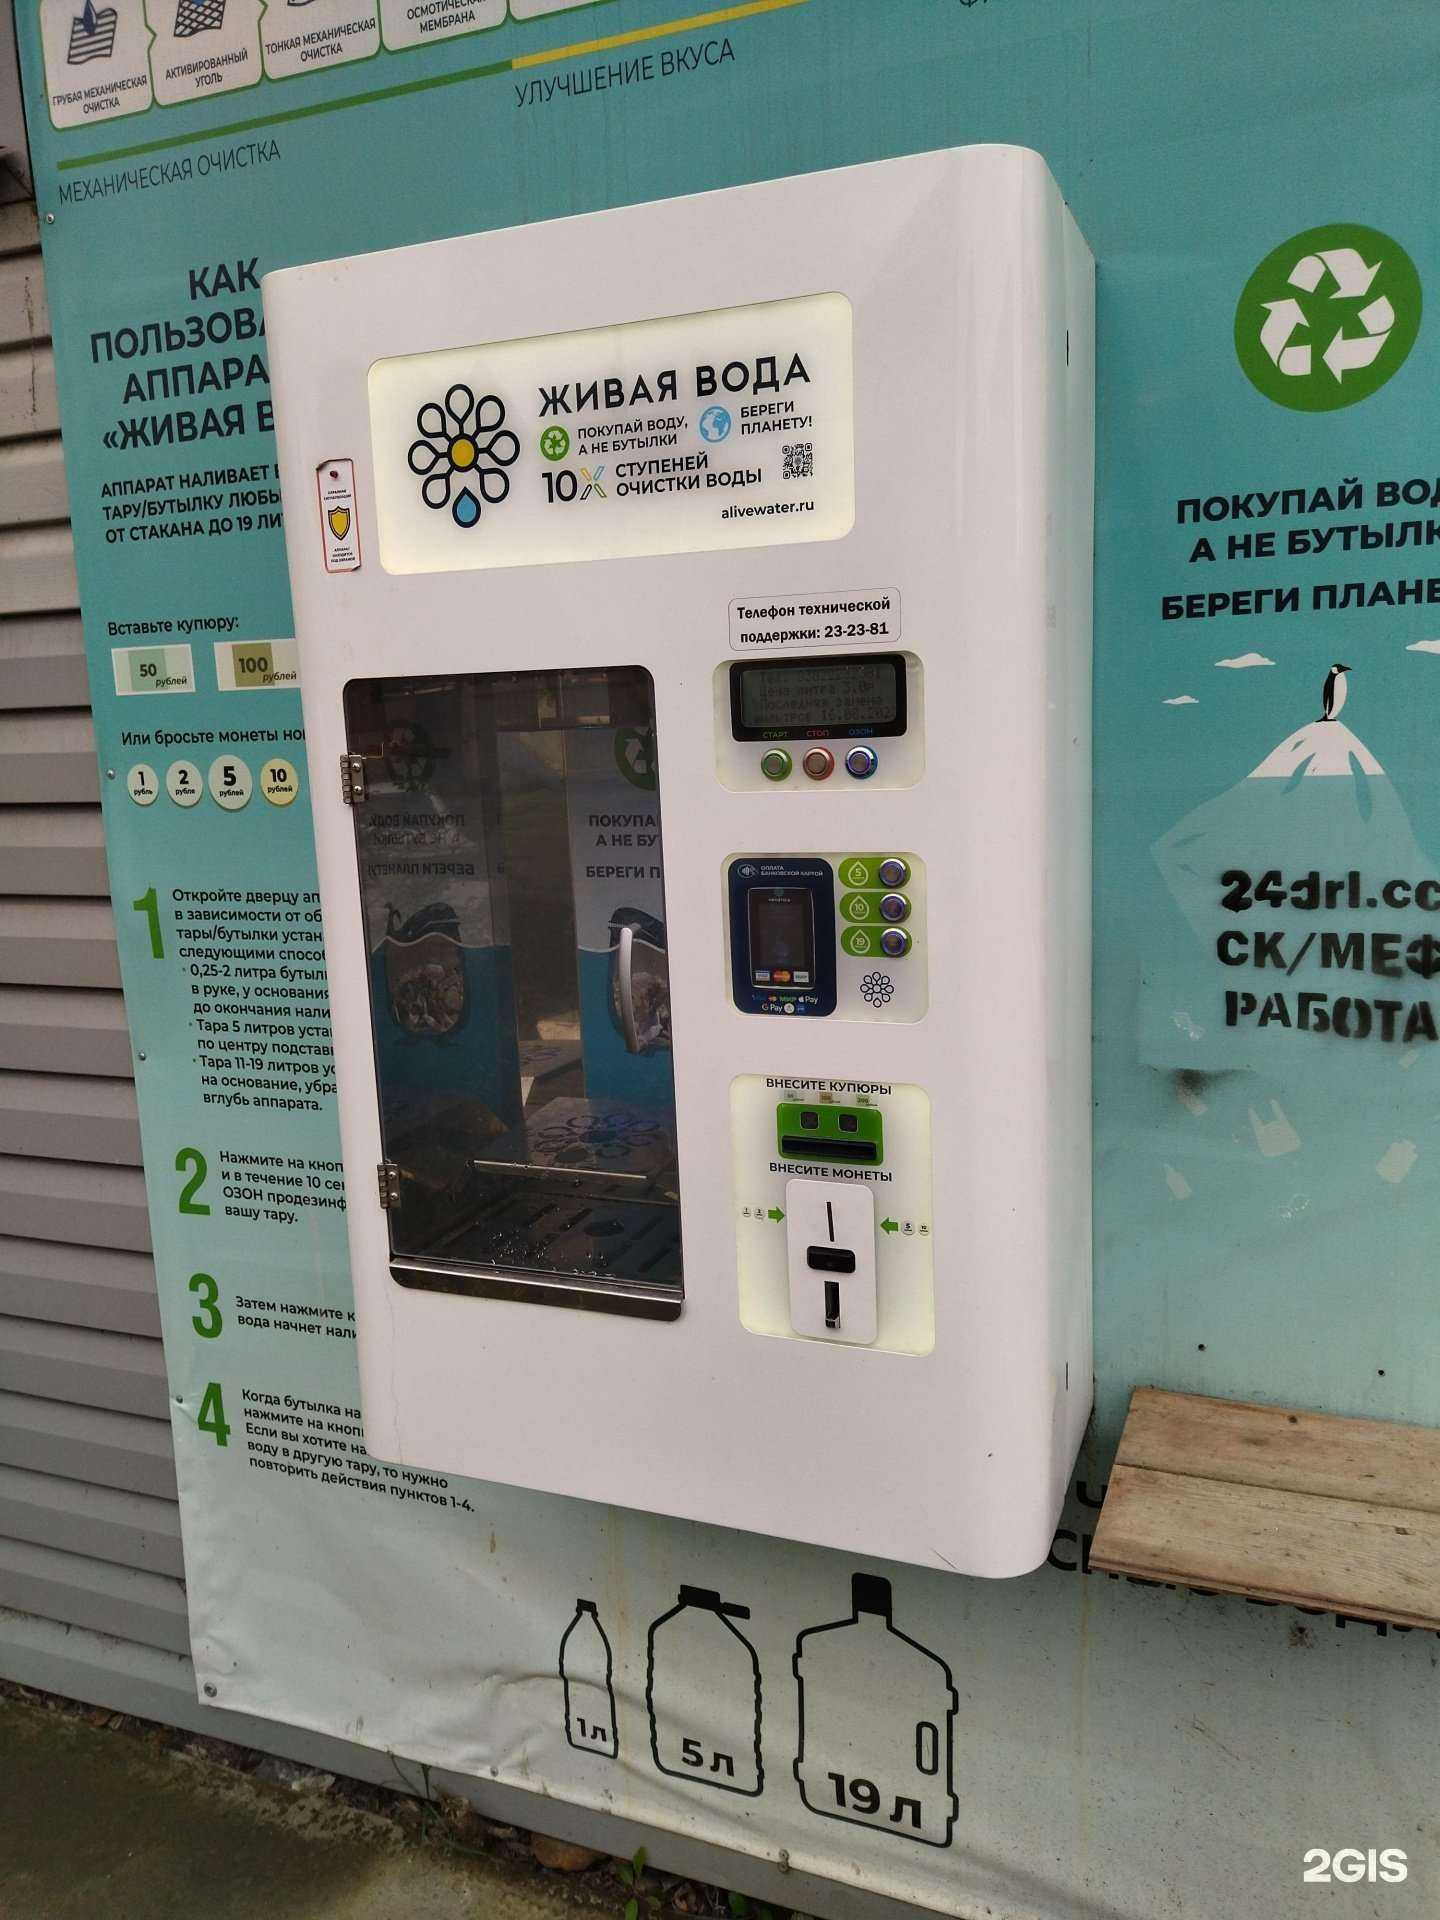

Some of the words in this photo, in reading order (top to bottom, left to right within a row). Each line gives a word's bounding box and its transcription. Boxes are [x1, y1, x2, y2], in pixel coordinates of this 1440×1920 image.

[407, 0, 486, 20] ОСМОТИЧЕСК
[420, 10, 476, 33] МЕМБРАНА
[265, 37, 301, 55] ТОНКАЯ
[302, 18, 376, 47] МЕХАНИЧЕСКАЯ
[300, 42, 343, 62] ОЧИСТКА
[165, 49, 249, 80] АКТИВИРОВАННЫЙ
[515, 55, 655, 108] УЛУЧШЕНИЕ
[661, 38, 735, 77] ВКУСА
[53, 91, 83, 106] ГРУБАЯ
[84, 75, 148, 99] МЕХАНИЧЕСКАЯ
[195, 73, 223, 88] УГОЛЬ
[83, 98, 121, 114] ОЧИСТКА
[58, 158, 193, 206] МЕХАНИЧЕСКАЯ
[197, 139, 281, 176] ОЧИСТКА
[189, 257, 261, 301] КАК
[539, 370, 678, 417] ЖИВАЯ
[696, 352, 811, 397] ВОДА
[740, 401, 795, 418] БЕРЕГИ
[103, 404, 245, 450] «ЖИВАЯ
[578, 419, 643, 439] ПОКУПАЙ
[647, 416, 688, 431] ВОДУ,
[741, 416, 813, 435] ПЛАНЕТУ!
[578, 444, 588, 456] А
[591, 442, 609, 454] НЕ
[612, 434, 678, 451] БУТЫЛКИ
[615, 452, 708, 478] СТУПЕНЕЙ
[101, 475, 175, 498] АППАРАТ
[179, 465, 270, 489] НАЛИВАЕТ
[616, 473, 701, 497] ОЧИСТКИ
[706, 468, 762, 488] ВОДЫ
[103, 494, 224, 520] ТАРУ/БУТЫЛКУ
[721, 500, 815, 519] alivewater.ru
[1177, 477, 1363, 524] ПОКУПАЙ
[105, 528, 126, 544] ОТ
[130, 521, 204, 541] СТАКАНА
[208, 519, 233, 536] ДО
[237, 516, 253, 531] 19
[1189, 538, 1216, 563] А
[1227, 532, 1276, 560] НЕ
[737, 605, 796, 620] Телефон
[799, 596, 891, 616] технической
[1162, 587, 1299, 620] БЕРЕГИ
[108, 619, 173, 636] Вставьте
[177, 616, 239, 635] купюру:
[740, 629, 820, 643] поддержки:
[824, 622, 889, 638] 23-23-81
[139, 663, 157, 678] 50
[239, 657, 268, 673] 100
[156, 675, 187, 688] рублей
[262, 671, 297, 684] рублей
[122, 731, 151, 746] Или
[154, 730, 214, 748] бросьте
[219, 728, 279, 743] монеты
[806, 730, 829, 738] СТОП
[849, 728, 873, 737] ОЗОН
[138, 771, 146, 786] 1
[178, 769, 189, 785] 2
[223, 765, 237, 787] 5
[270, 768, 287, 783] 10
[595, 834, 608, 847] А
[612, 834, 633, 847] НЕ
[586, 866, 646, 879] БЕРЕГИ
[133, 887, 165, 960] 1
[172, 888, 242, 905] Откройте
[246, 890, 299, 906] дверцу
[175, 909, 183, 920] в
[187, 909, 281, 922] зависимости
[285, 911, 302, 922] от
[176, 925, 278, 942] тары/бутылки
[179, 946, 275, 961] следующими
[190, 964, 231, 979] 0,25-2
[234, 966, 276, 981] литра
[191, 984, 200, 995] в
[203, 984, 240, 998] руке,
[242, 987, 251, 999] у
[193, 1003, 211, 1015] до
[214, 1003, 291, 1017] окончания
[770, 1003, 783, 1013] Pay
[196, 1019, 229, 1035] Тара
[232, 1020, 241, 1033] 5
[244, 1022, 295, 1040] литров
[197, 1038, 215, 1050] по
[218, 1040, 268, 1055] центру
[200, 1055, 232, 1071] Тара
[234, 1057, 264, 1070] 11-19
[267, 1060, 319, 1076] литров
[201, 1074, 218, 1086] на
[221, 1076, 302, 1092] основание,
[766, 1078, 826, 1091] ВНЕСИТЕ
[830, 1081, 892, 1095] КУПЮРЫ
[203, 1092, 250, 1108] вглубь
[253, 1095, 323, 1112] аппарата.
[175, 1147, 211, 1216] 2
[219, 1150, 284, 1168] Нажмите
[288, 1157, 305, 1169] на
[221, 1170, 230, 1181] и
[234, 1171, 242, 1182] в
[245, 1172, 303, 1188] течение
[306, 1175, 321, 1189] 10
[769, 1162, 829, 1177] ВНЕСИТЕ
[832, 1169, 892, 1182] МОНЕТЫ
[223, 1186, 263, 1201] ОЗОН
[225, 1205, 260, 1221] вашу
[264, 1208, 299, 1225] тару.
[188, 1272, 223, 1339] 3
[235, 1295, 277, 1312] Затем
[280, 1303, 343, 1320] нажмите
[238, 1314, 270, 1330] вода
[273, 1318, 322, 1335] начнет
[197, 1382, 231, 1447] 4
[241, 1389, 281, 1407] Когда
[284, 1394, 341, 1416] бутылка
[244, 1408, 303, 1426] нажмите
[307, 1416, 324, 1430] на
[246, 1422, 278, 1438] Если
[281, 1429, 299, 1443] вы
[302, 1433, 347, 1452] хотите
[248, 1440, 279, 1457] воду
[282, 1445, 290, 1457] в
[293, 1449, 343, 1471] другую
[346, 1458, 380, 1478] тару,
[383, 1465, 399, 1479] то
[402, 1470, 448, 1490] нужно
[250, 1456, 318, 1480] повторить
[321, 1470, 386, 1493] действия
[390, 1484, 448, 1507] пунктов
[450, 1495, 475, 1513] 1-4.
[682, 1737, 704, 1767] 5
[828, 1772, 881, 1815] 19
